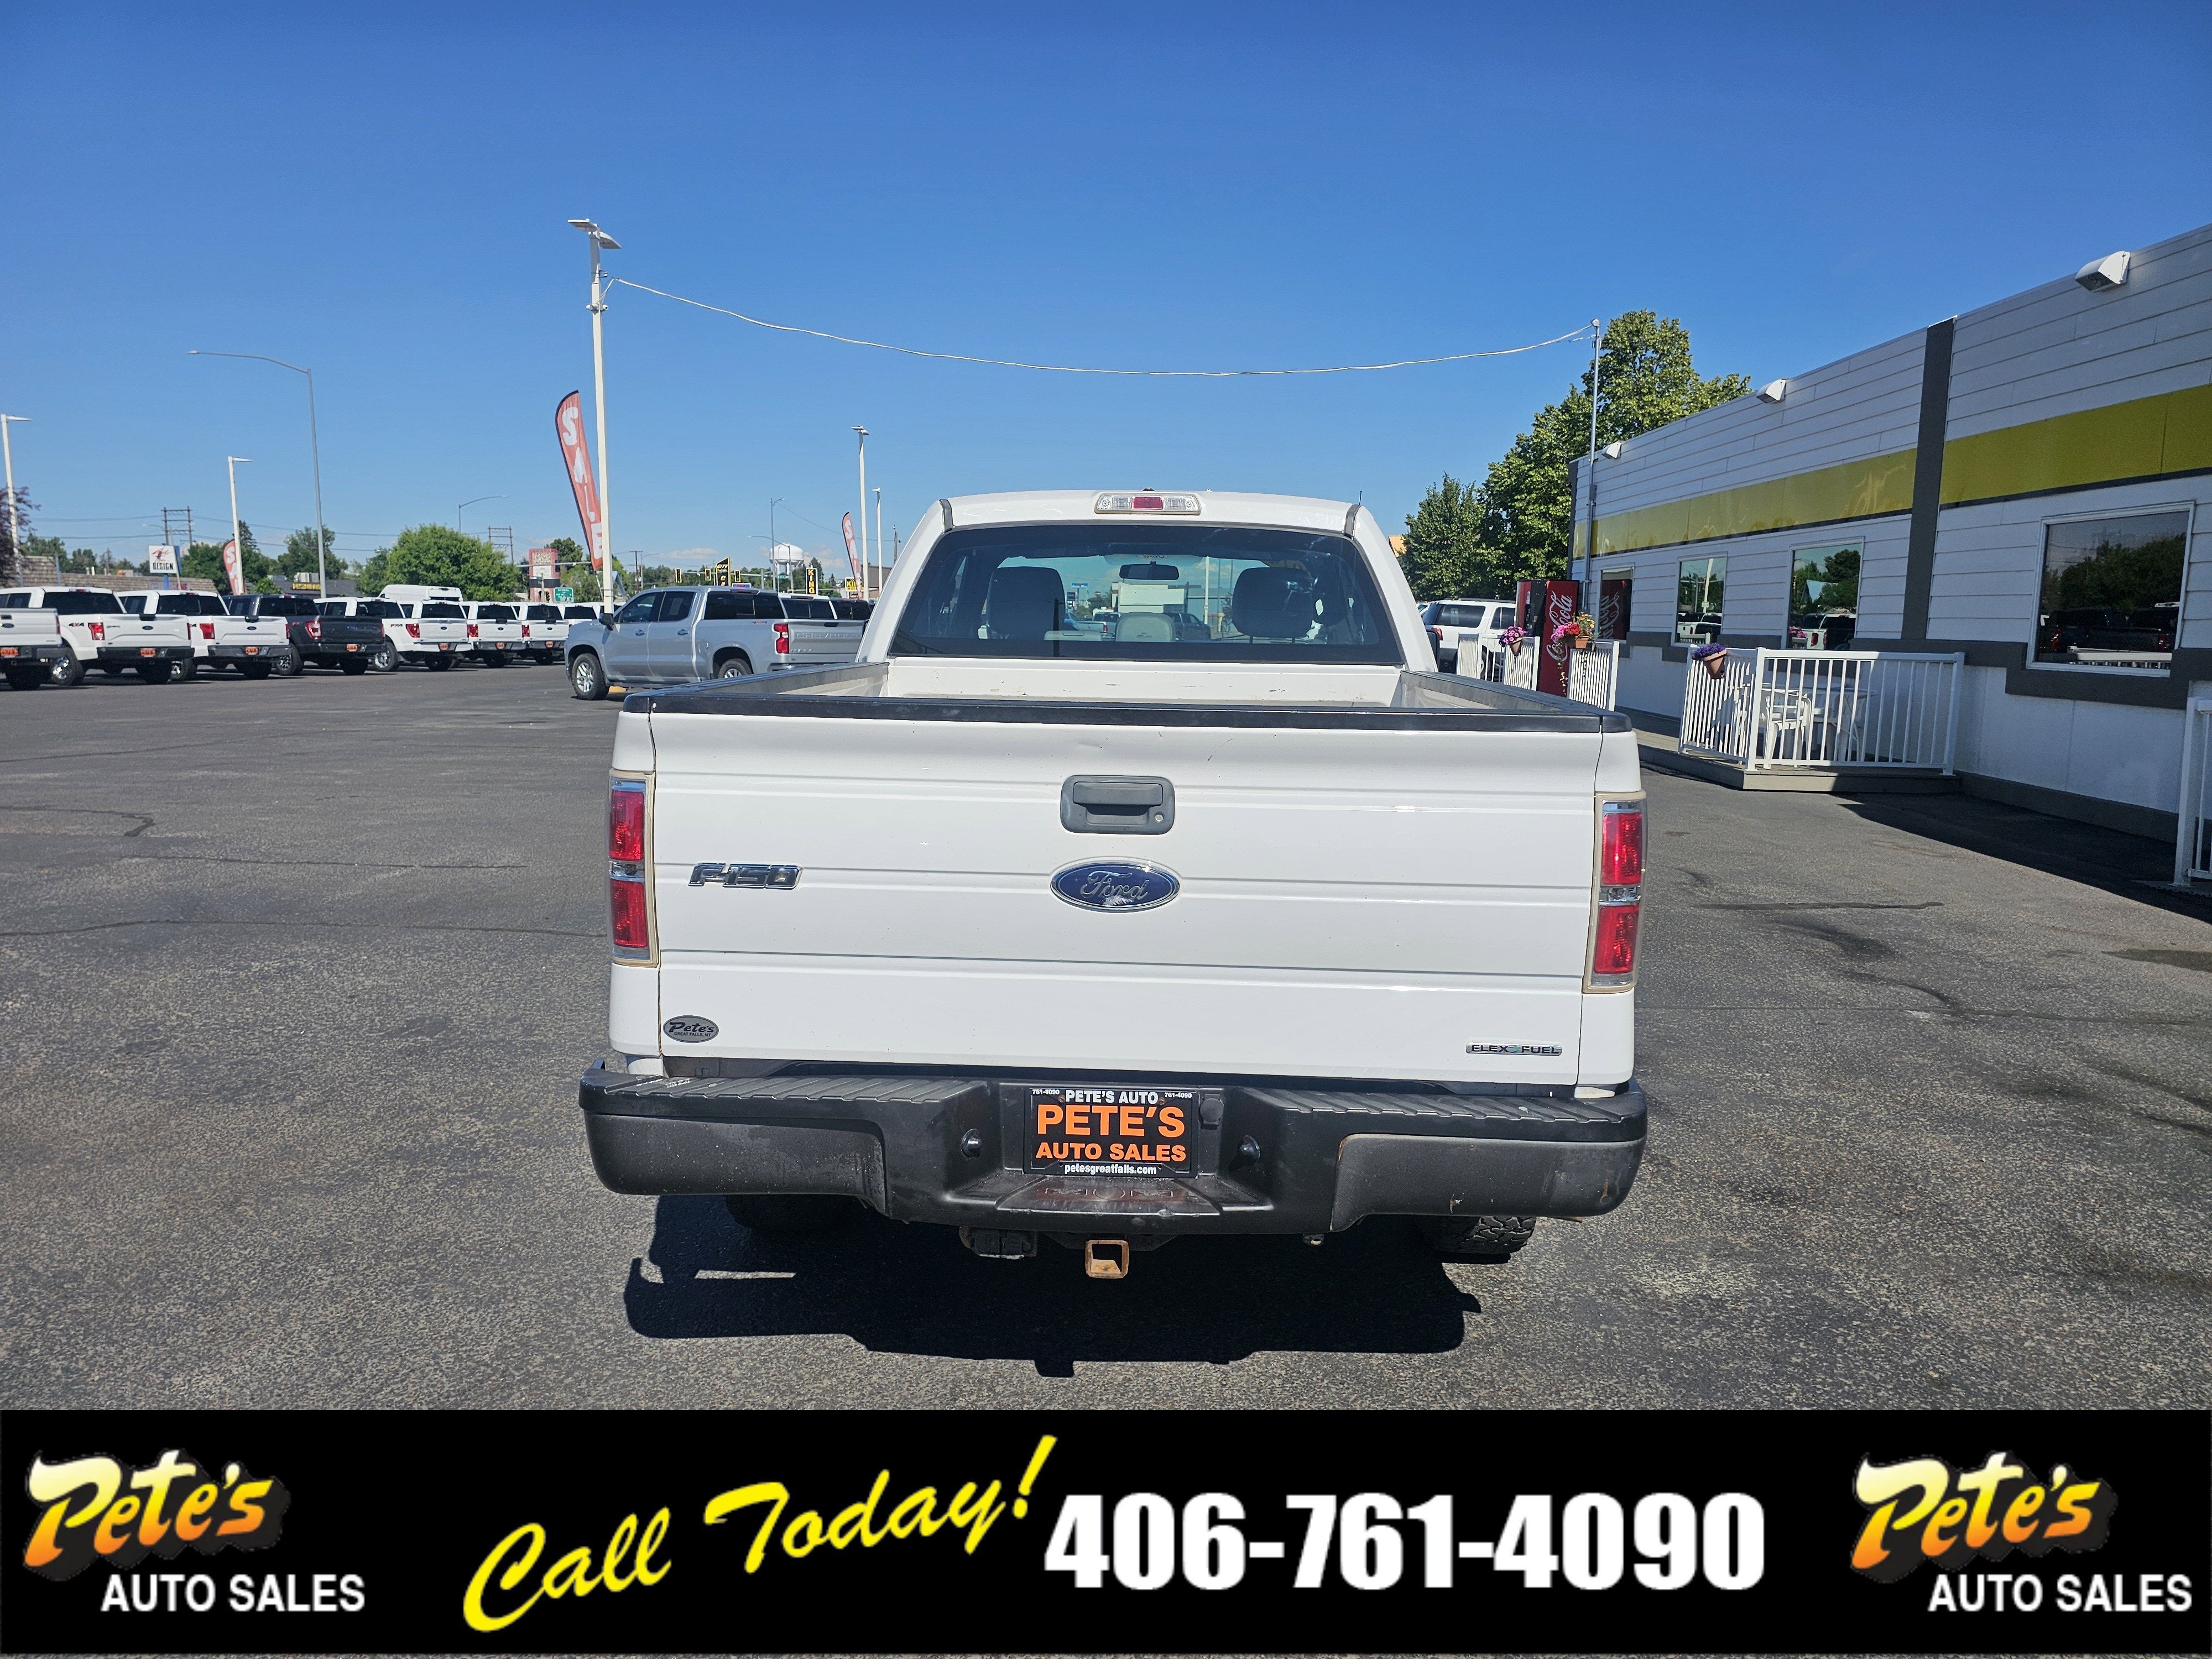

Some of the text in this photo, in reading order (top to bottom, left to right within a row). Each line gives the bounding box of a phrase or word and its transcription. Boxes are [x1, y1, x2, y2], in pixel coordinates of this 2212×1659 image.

[1546, 590, 1573, 661] Co-Cola
[688, 863, 802, 890] F-150
[1080, 870, 1150, 900] Ford
[669, 1021, 715, 1033] Pete's
[1472, 1044, 1559, 1054] FLEX FUEL
[1065, 1090, 1159, 1104] PETE'S AUTO
[1037, 1104, 1185, 1138] PETE'S
[1035, 1142, 1186, 1162] AUTO SALES
[1065, 1164, 1157, 1175] petesgreatfalls.com
